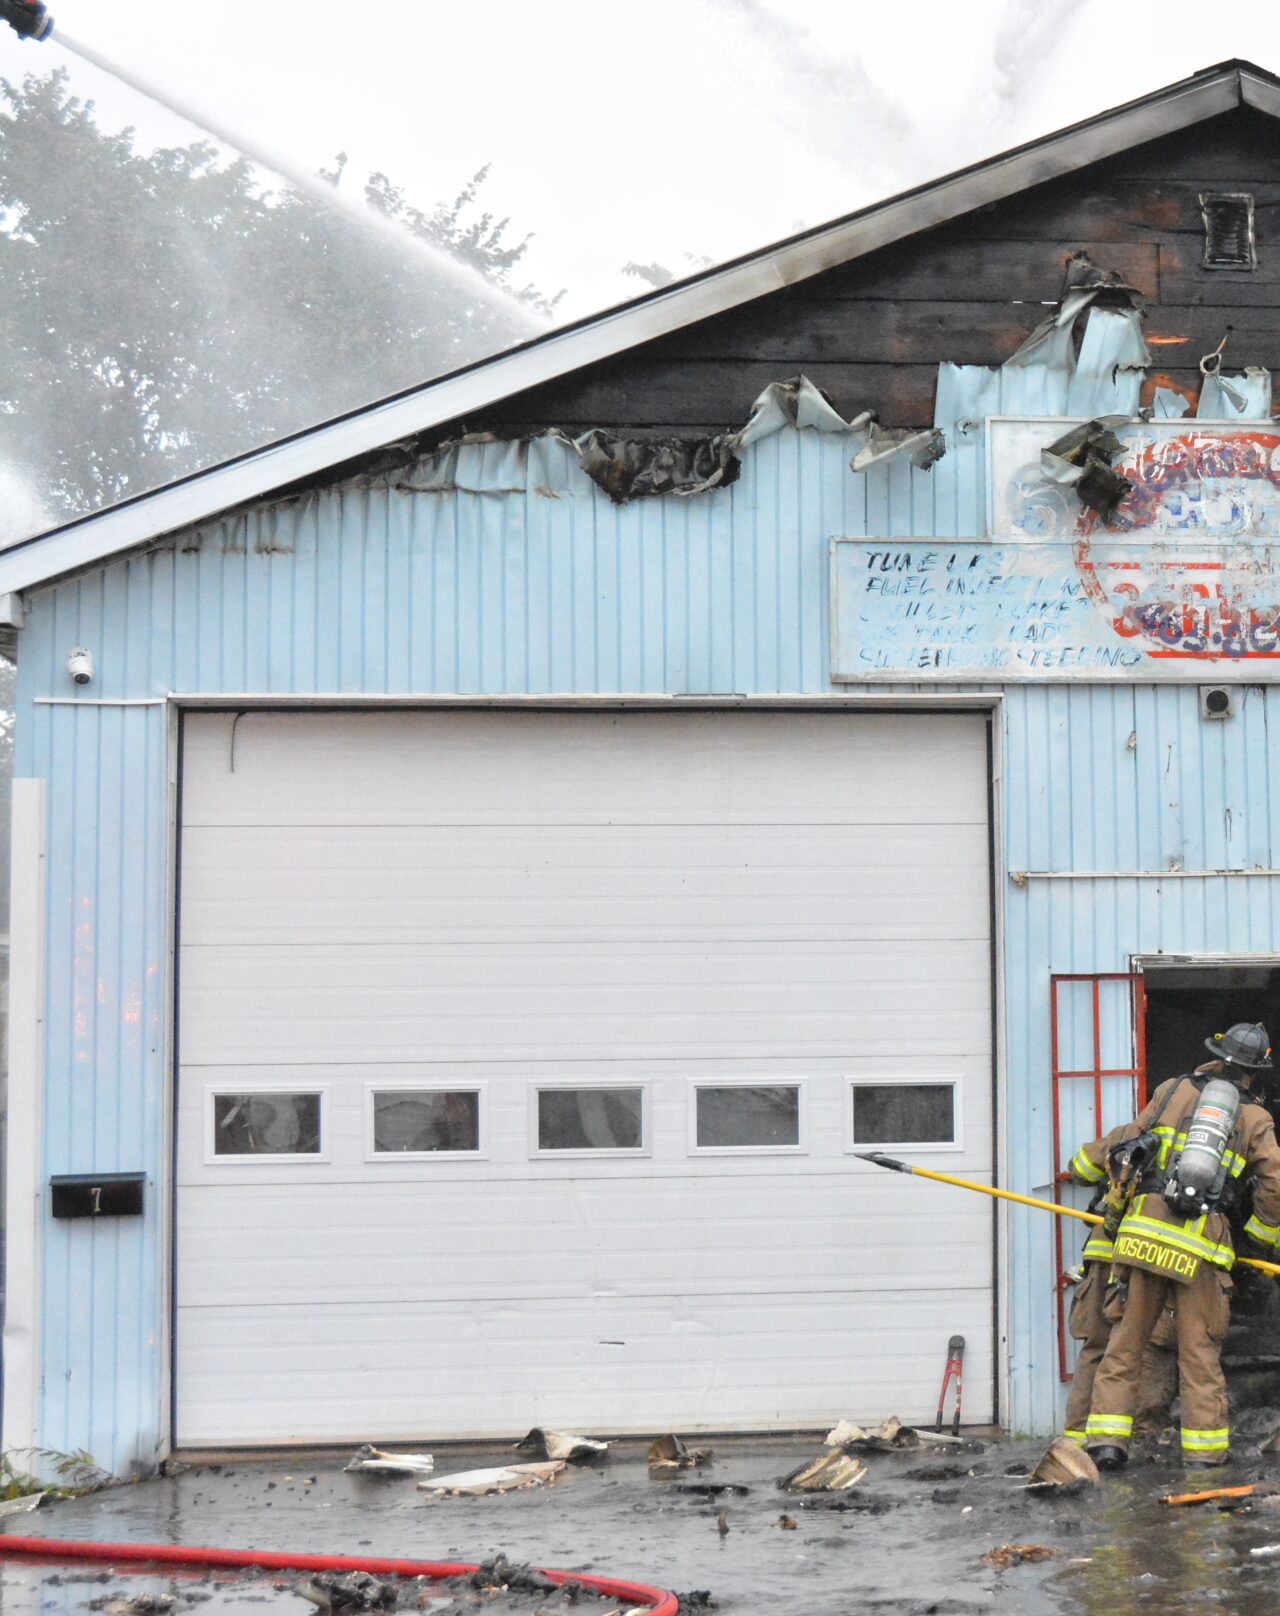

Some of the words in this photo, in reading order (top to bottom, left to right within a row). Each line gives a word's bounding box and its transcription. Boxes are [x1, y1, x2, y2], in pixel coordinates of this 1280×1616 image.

[946, 576, 1081, 596] INJECTIN
[91, 1187, 102, 1212] 7
[1113, 1236, 1197, 1278] MOSCOVITCH
